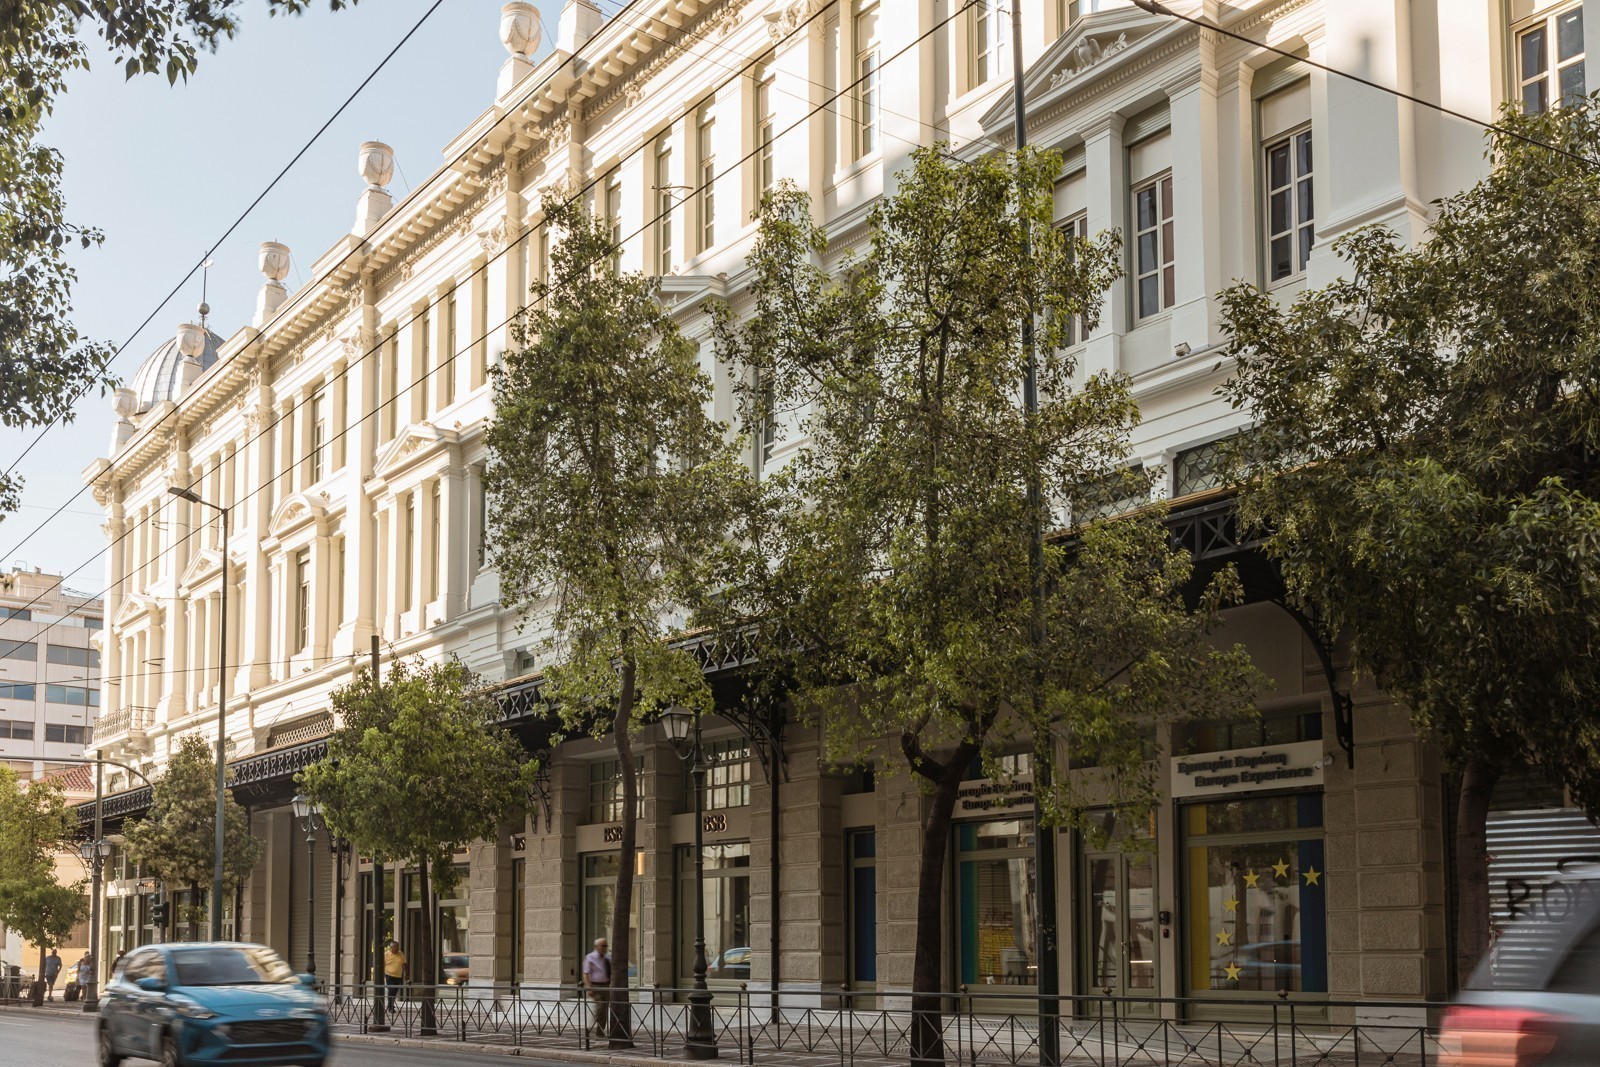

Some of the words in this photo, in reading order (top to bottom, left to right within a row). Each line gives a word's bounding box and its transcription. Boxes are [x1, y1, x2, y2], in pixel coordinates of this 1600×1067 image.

[1234, 751, 1287, 769] Ευρώπη
[1194, 774, 1239, 788] Europa
[1240, 766, 1313, 785] Experience
[704, 814, 727, 833] BSB
